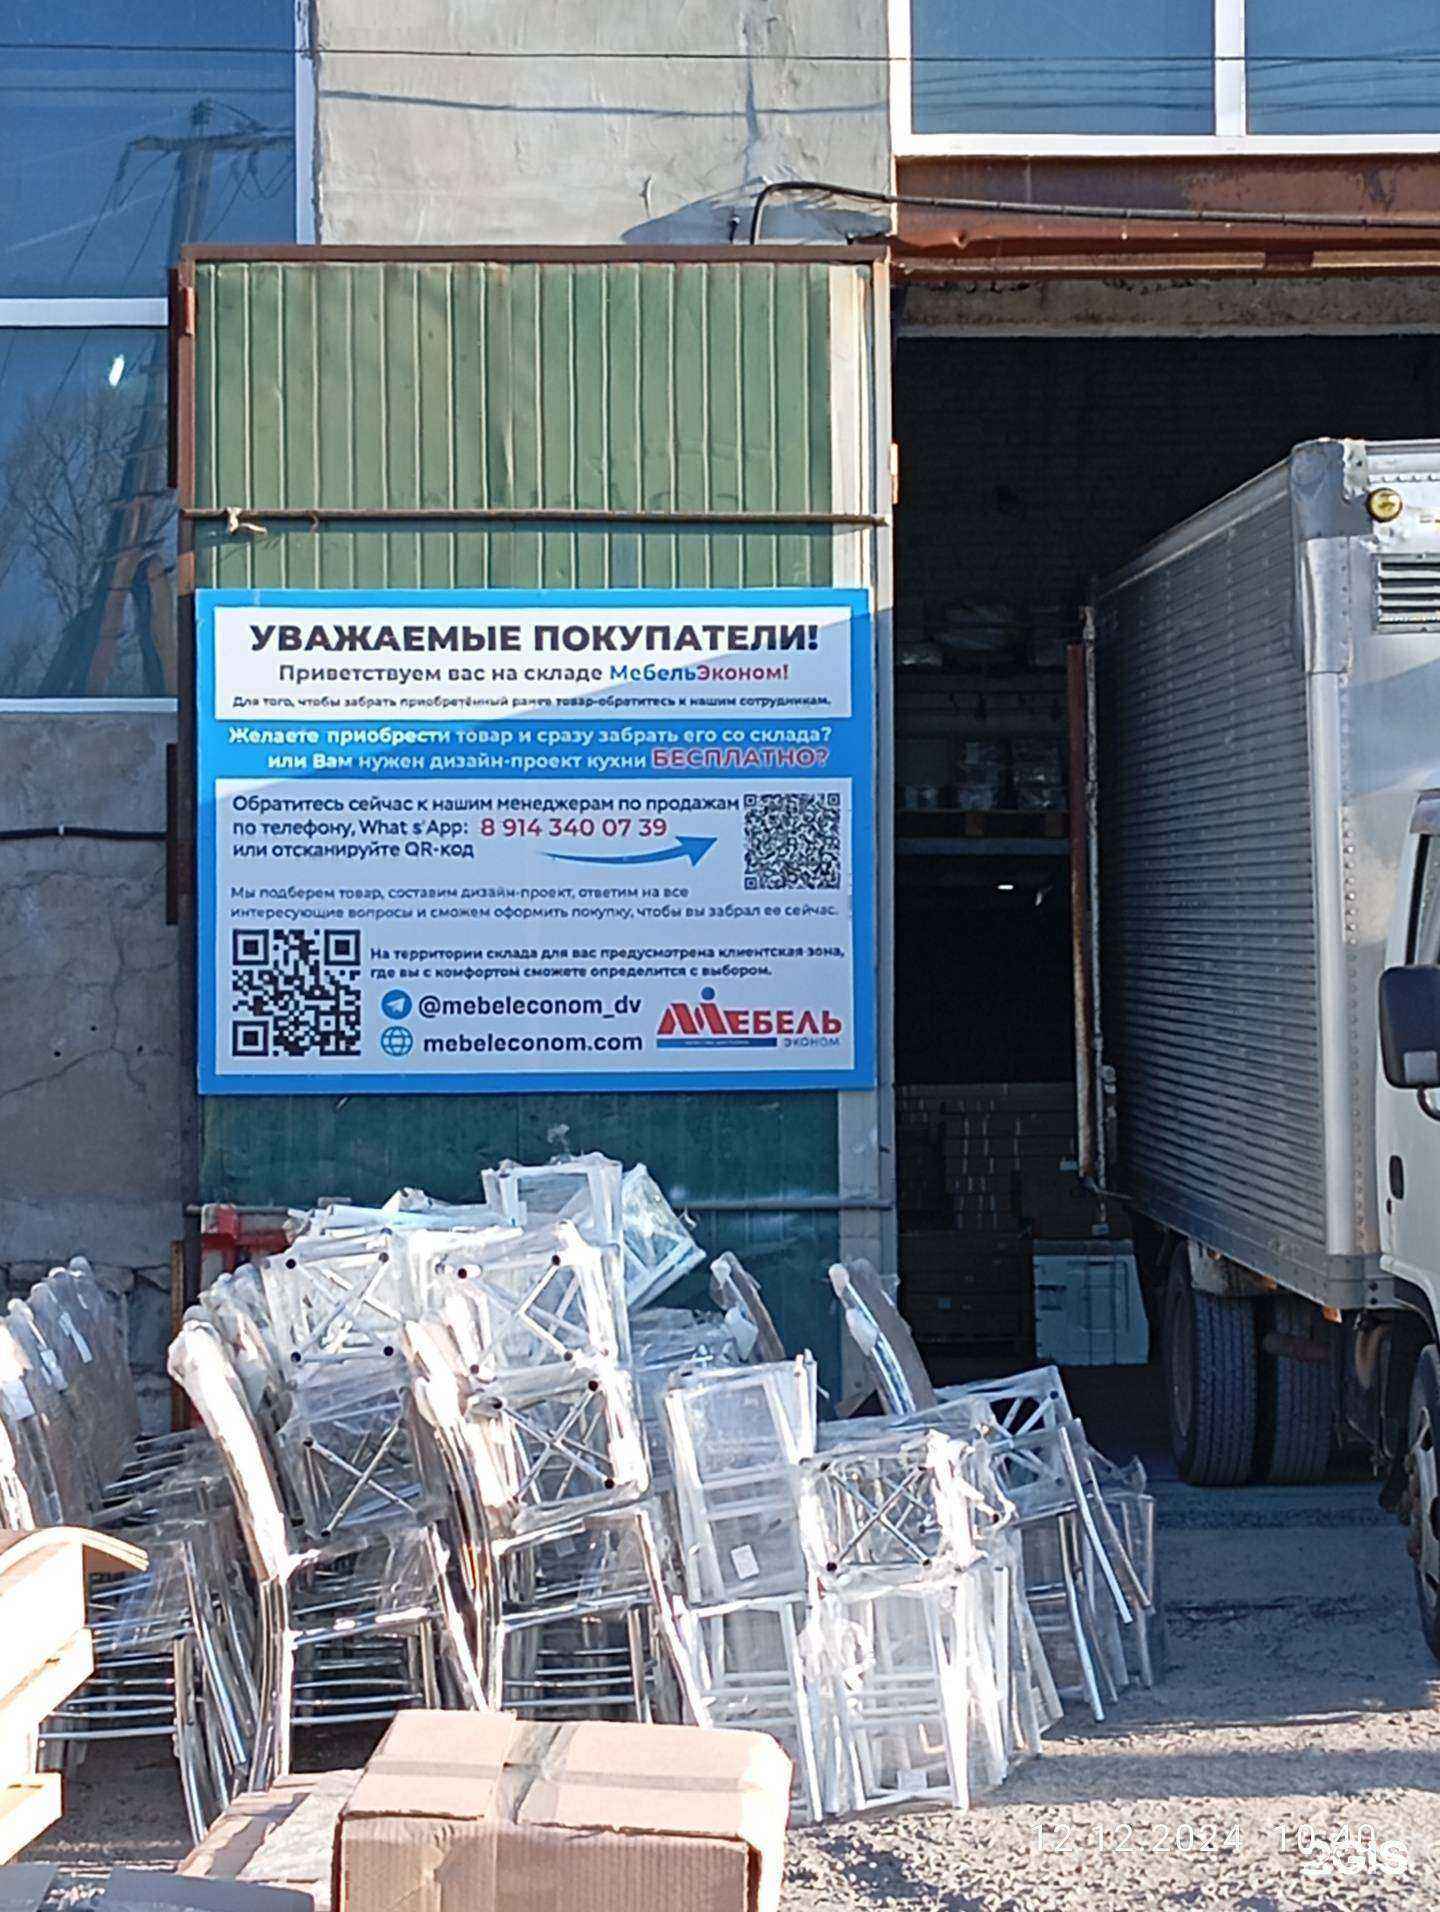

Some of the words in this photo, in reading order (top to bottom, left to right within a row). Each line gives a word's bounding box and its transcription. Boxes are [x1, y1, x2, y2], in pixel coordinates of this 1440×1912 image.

[250, 624, 522, 652] УВАЖАЕМЫЕ
[534, 624, 819, 651] ПОКУПАТЕЛИ!
[279, 664, 441, 685] Приветствуем
[449, 668, 485, 682] вас
[492, 668, 518, 682] на
[525, 667, 602, 683] складе
[609, 663, 789, 682] МебельЭконом!
[232, 696, 259, 708] Для
[263, 698, 295, 708] того,
[298, 695, 341, 708] чтобы
[344, 695, 397, 709] забрать
[556, 695, 676, 709] товар-обратитесь
[679, 697, 687, 707] к
[689, 697, 736, 707] нашим
[740, 695, 832, 709] сотрудникам.
[228, 727, 319, 744] Желаете
[326, 727, 450, 747] приобрести
[456, 730, 513, 746] товар
[519, 730, 532, 742] и
[537, 730, 594, 747] сразу
[597, 727, 678, 746] забрать
[684, 730, 716, 743] его
[723, 730, 745, 743] со
[750, 727, 832, 744] склада?
[268, 754, 309, 769] или
[312, 753, 353, 769] Вам
[359, 755, 425, 773] нужен
[429, 752, 581, 772] дизайн-проект
[587, 755, 647, 772] кухни
[653, 747, 829, 770] БЕСПЛАТНО?
[232, 795, 344, 814] Обратитесь
[349, 796, 414, 812] сейчас
[417, 799, 428, 811] к
[432, 799, 492, 811] нашим
[497, 798, 614, 814] менеджерам
[618, 798, 641, 811] по
[646, 798, 740, 814] продажам
[233, 822, 256, 835] по
[261, 819, 356, 838] телефону,
[359, 819, 407, 835] What
[480, 818, 495, 837] 8
[503, 818, 543, 837] 914
[548, 818, 595, 837] 340
[602, 818, 632, 837] 07
[638, 818, 667, 837] 39
[233, 844, 267, 857] или
[272, 841, 400, 860] отсканируйте
[404, 841, 475, 859] QR-код
[231, 887, 255, 899] Мы
[259, 886, 336, 901] подберем
[339, 888, 386, 901] товар,
[388, 888, 457, 899] составим
[460, 885, 576, 901] дизайн-проект,
[578, 887, 639, 899] ответим
[642, 888, 660, 898] на
[664, 888, 689, 898] все
[231, 907, 344, 921] интересующие
[348, 907, 413, 920] вопросы
[417, 907, 427, 918] и
[430, 907, 490, 918] сможем
[494, 905, 568, 921] оформить
[571, 906, 635, 921] покупку,
[637, 904, 682, 918] чтобы
[686, 906, 705, 917] вы
[708, 904, 760, 918] забрал
[764, 906, 782, 917] ее
[785, 903, 839, 917] сейчас.
[370, 948, 390, 960] На
[394, 948, 483, 963] территории
[487, 948, 538, 961] склада
[541, 948, 568, 960] для
[572, 948, 597, 959] вас
[601, 947, 715, 961] предусмотрена
[718, 946, 804, 958] клиентская
[807, 946, 845, 959] зона,
[370, 967, 395, 980] где
[399, 967, 417, 978] вы
[422, 967, 431, 978] с
[434, 965, 520, 980] комфортом
[524, 966, 587, 978] сможете
[590, 965, 686, 978] определится
[690, 966, 698, 976] с
[702, 964, 772, 978] выбором.
[418, 995, 642, 1019] @mebeleconom_dv
[656, 1002, 842, 1035] МЕБЕЛЬ
[423, 1033, 643, 1052] mebeleconom.com
[783, 1036, 841, 1048] ЭКОНОМ
